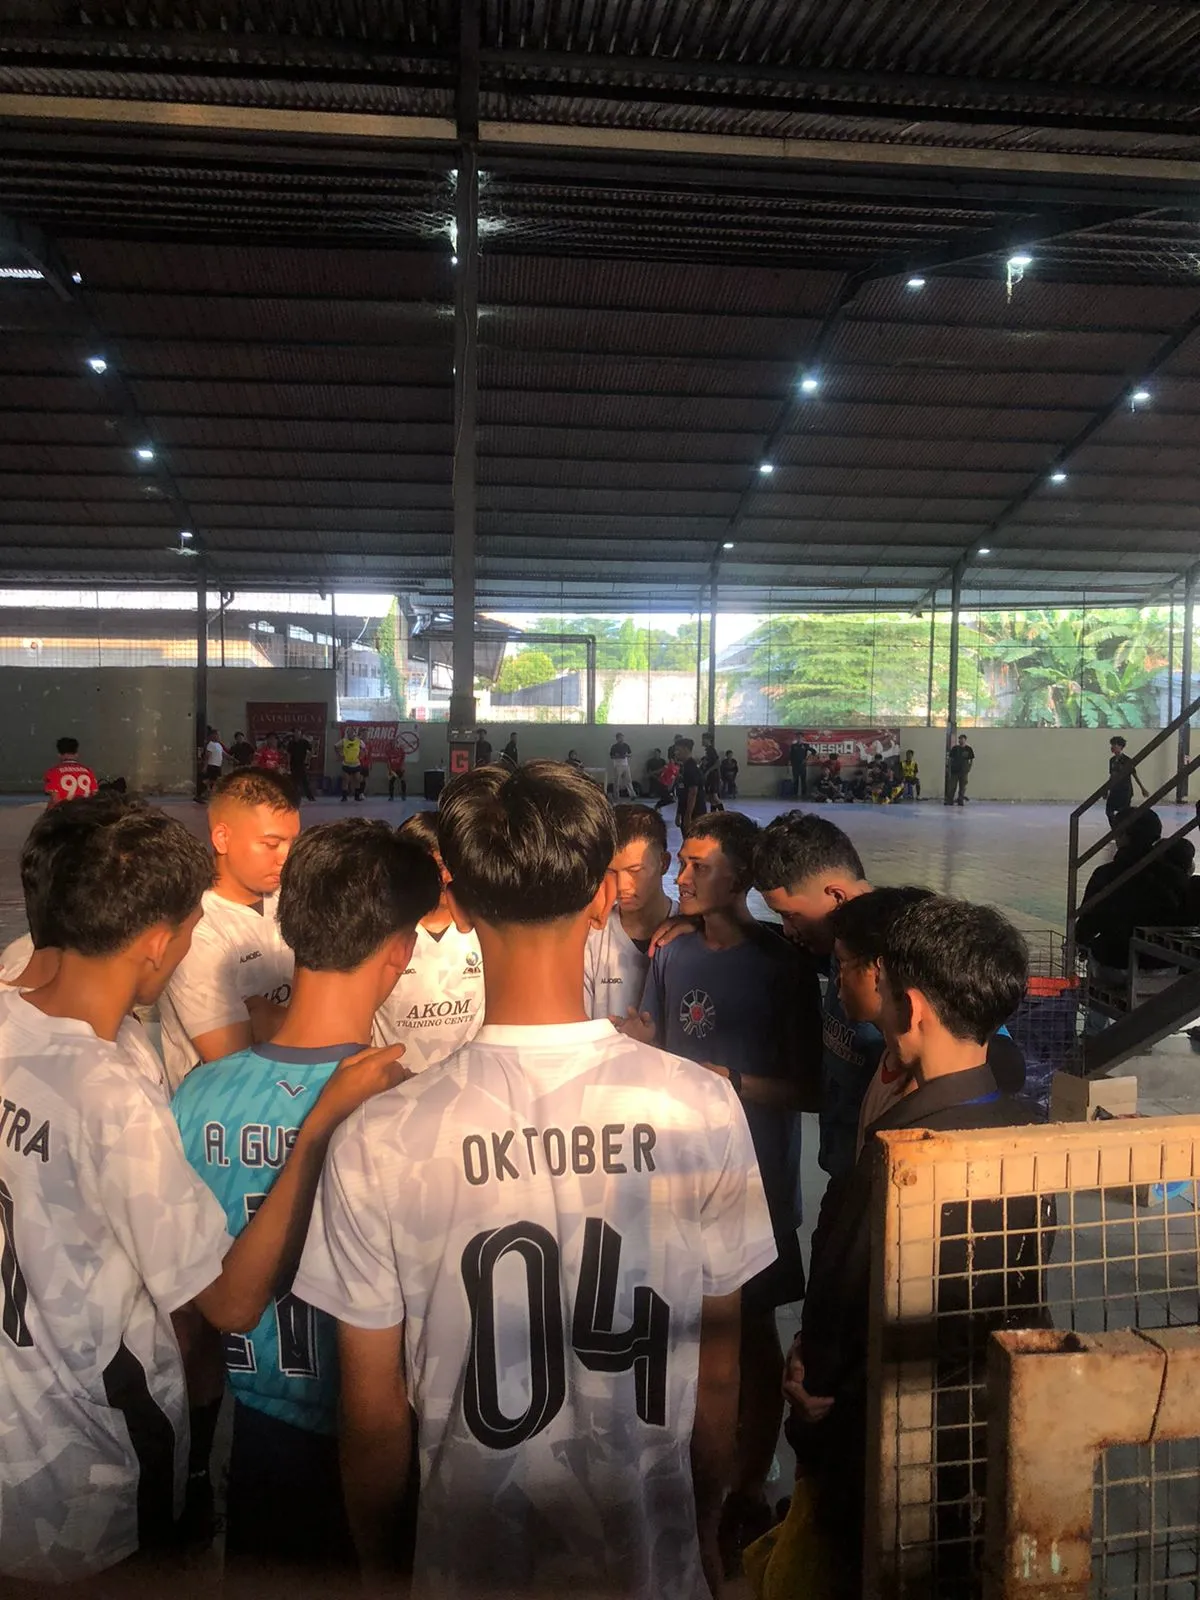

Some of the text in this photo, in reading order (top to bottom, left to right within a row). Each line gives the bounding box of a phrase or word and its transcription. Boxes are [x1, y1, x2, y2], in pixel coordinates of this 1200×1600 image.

[807, 740, 855, 754] NESHA
[60, 774, 91, 801] 99
[396, 1019, 442, 1029] TRAINING
[406, 998, 472, 1019] AKOM
[0, 1096, 50, 1163] TRA
[204, 1120, 231, 1167] A.
[461, 1122, 657, 1187] OKTOBER
[460, 1216, 671, 1451] 04
